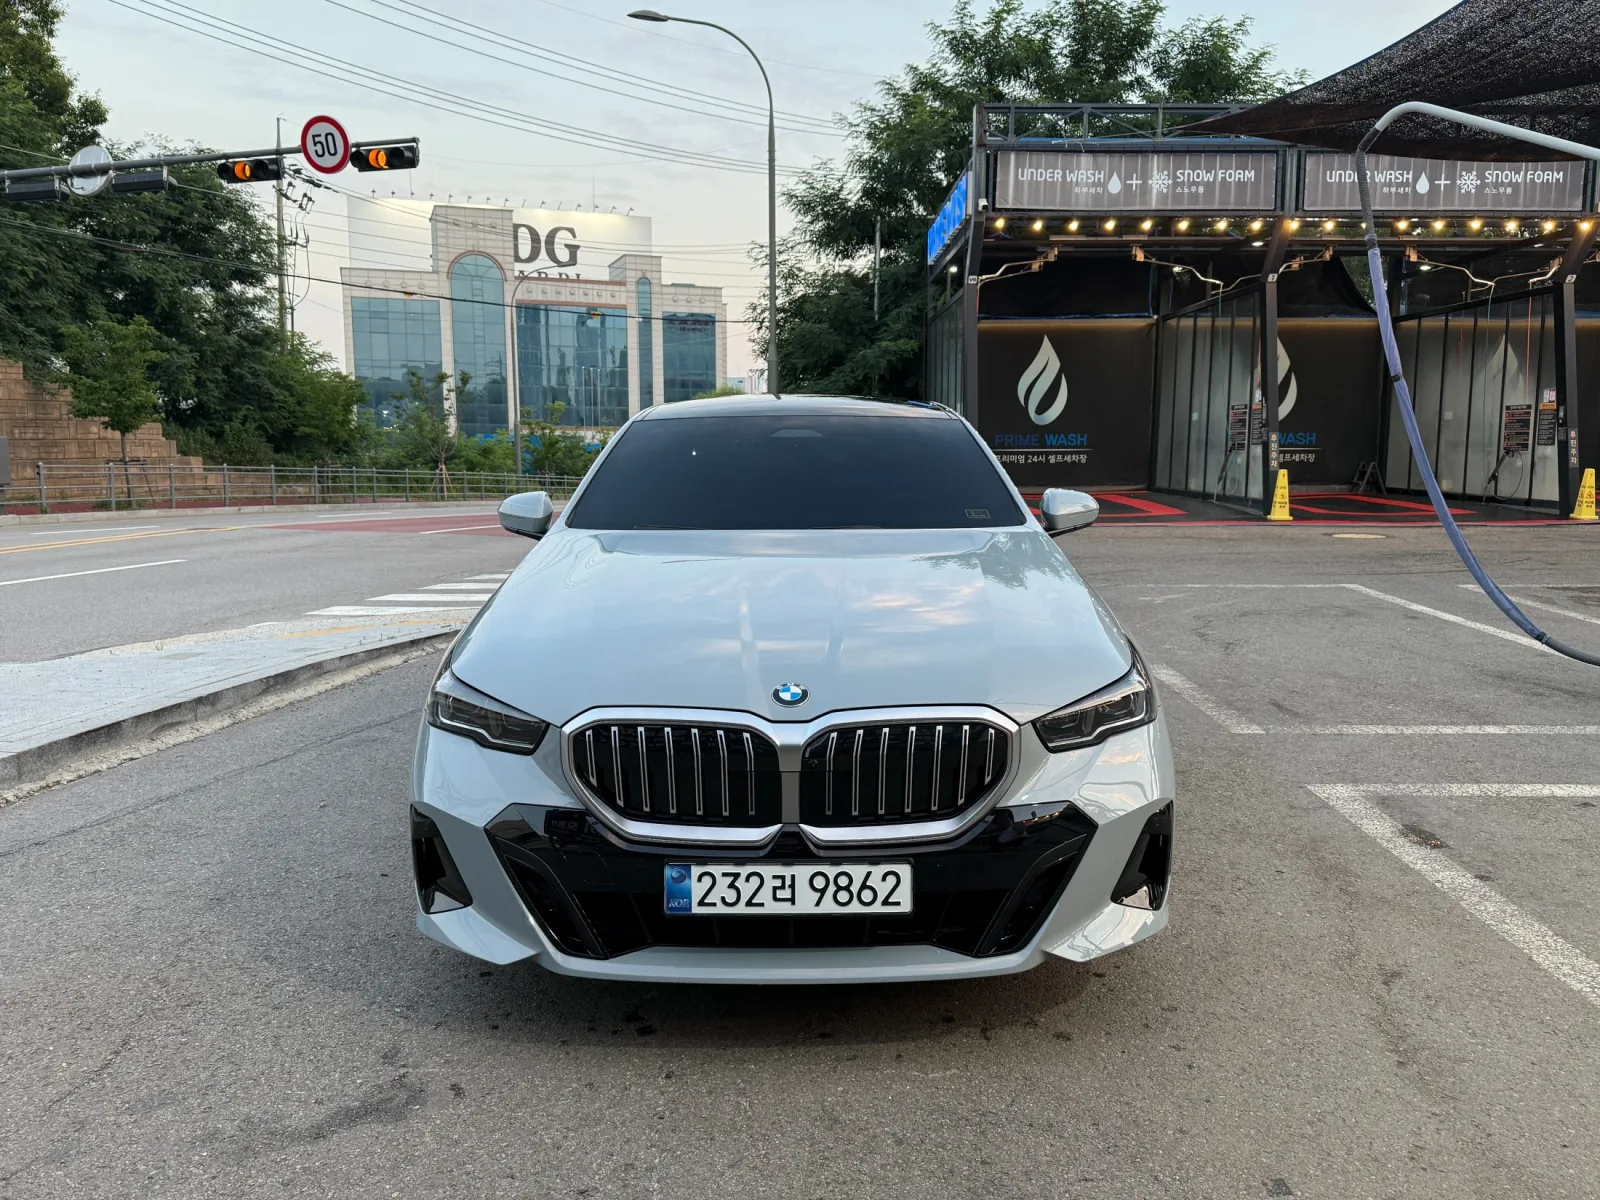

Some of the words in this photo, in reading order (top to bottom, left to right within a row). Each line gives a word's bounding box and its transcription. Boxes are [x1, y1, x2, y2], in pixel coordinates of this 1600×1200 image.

[311, 132, 338, 158] 50
[1018, 168, 1063, 182] UNDER
[1066, 169, 1104, 183] WASH
[1176, 169, 1215, 182] SNOW
[1218, 169, 1255, 182] FOAM
[1374, 170, 1413, 183] WASH
[1485, 170, 1524, 183] SNOW
[1526, 170, 1564, 183] FOAM
[1074, 186, 1103, 194] 하부세차
[1175, 185, 1205, 194] 스노우폼
[1382, 186, 1412, 194] 하부세차
[1483, 186, 1513, 195] 스노우폼
[513, 223, 581, 267] DG
[994, 434, 1040, 446] PRIME
[1045, 433, 1088, 446] WASH
[1270, 434, 1278, 468] 후진주차
[1027, 454, 1046, 464] 24시
[1047, 454, 1087, 464] 셀프세차장
[697, 871, 796, 907] 232러
[808, 870, 902, 907] 9862
